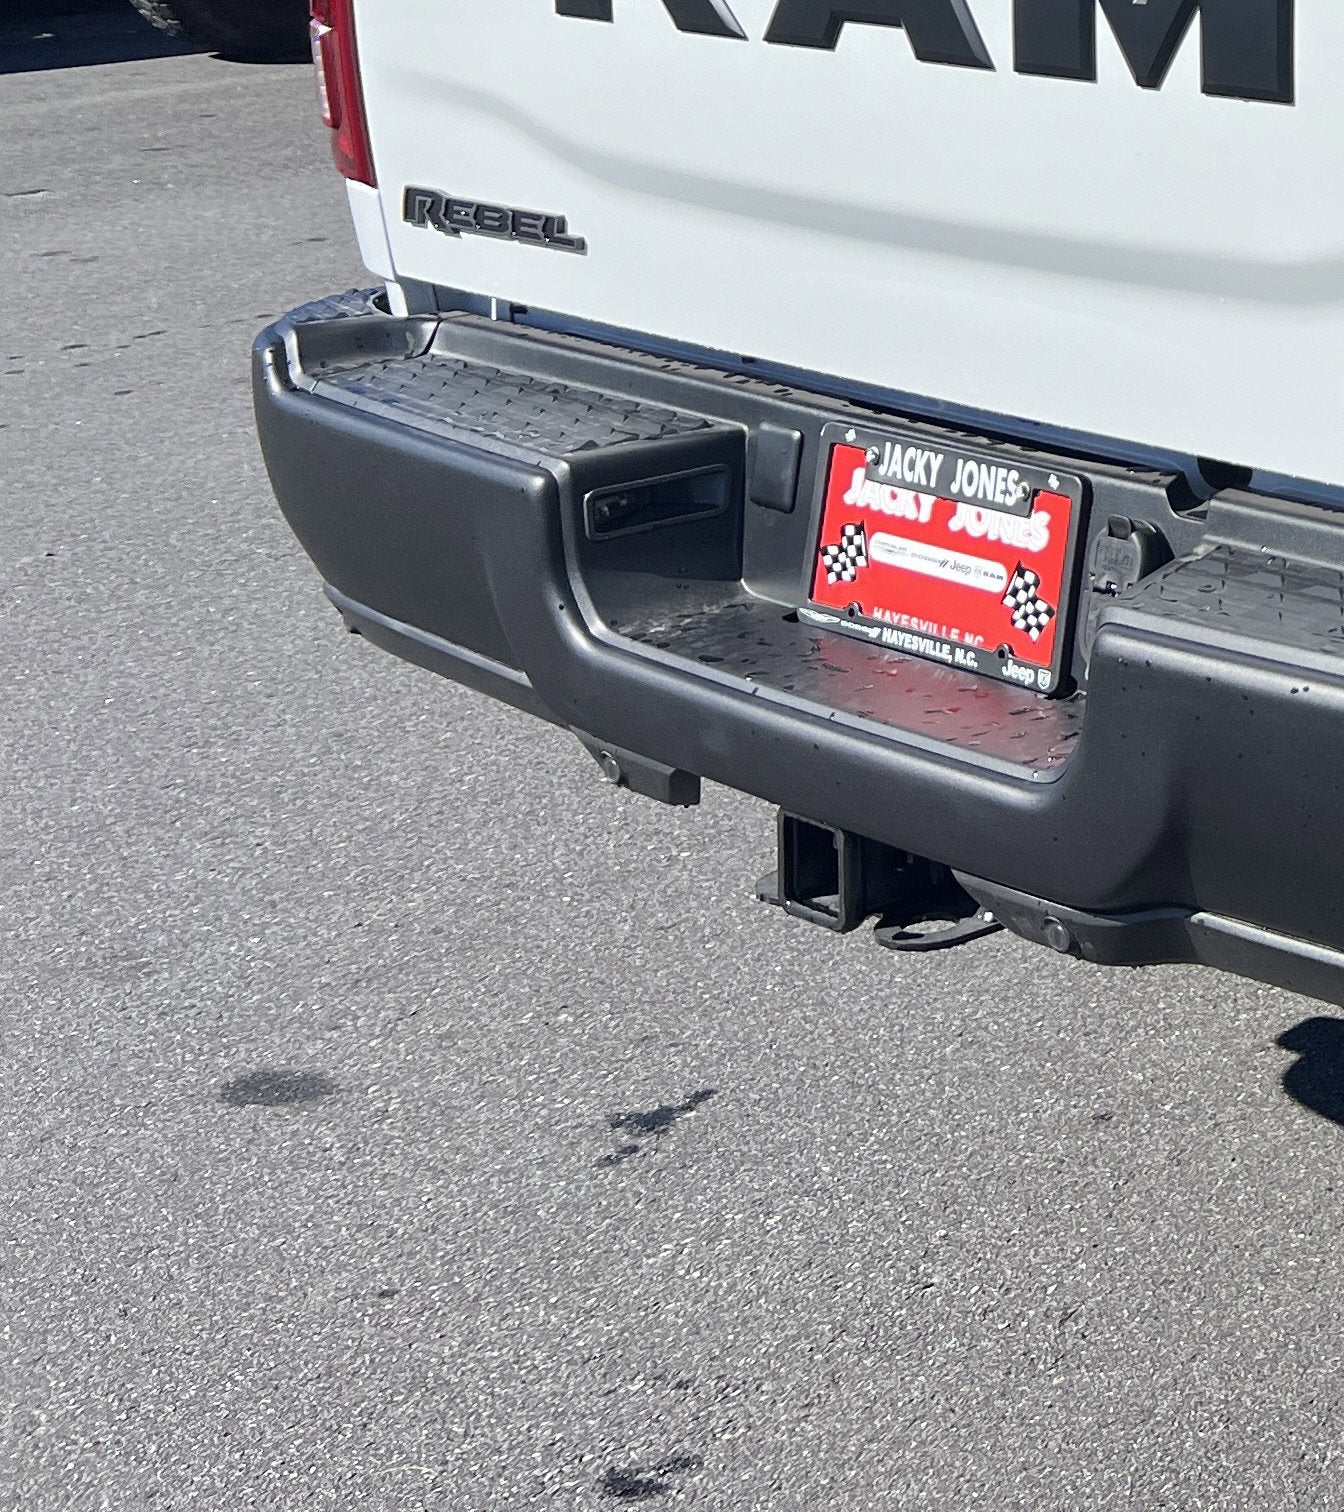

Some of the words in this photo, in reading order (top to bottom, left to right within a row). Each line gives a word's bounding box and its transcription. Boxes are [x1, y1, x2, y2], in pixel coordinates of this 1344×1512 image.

[402, 185, 588, 256] REBEL
[878, 441, 944, 488] JACKY
[950, 458, 1021, 506] JONES
[843, 467, 937, 523] JACKY
[948, 501, 1051, 553] JONES
[950, 559, 971, 576] Jeep
[882, 627, 953, 663] HAYESVILLE,
[955, 648, 978, 668] N.C.
[1002, 659, 1034, 685] Jeep
